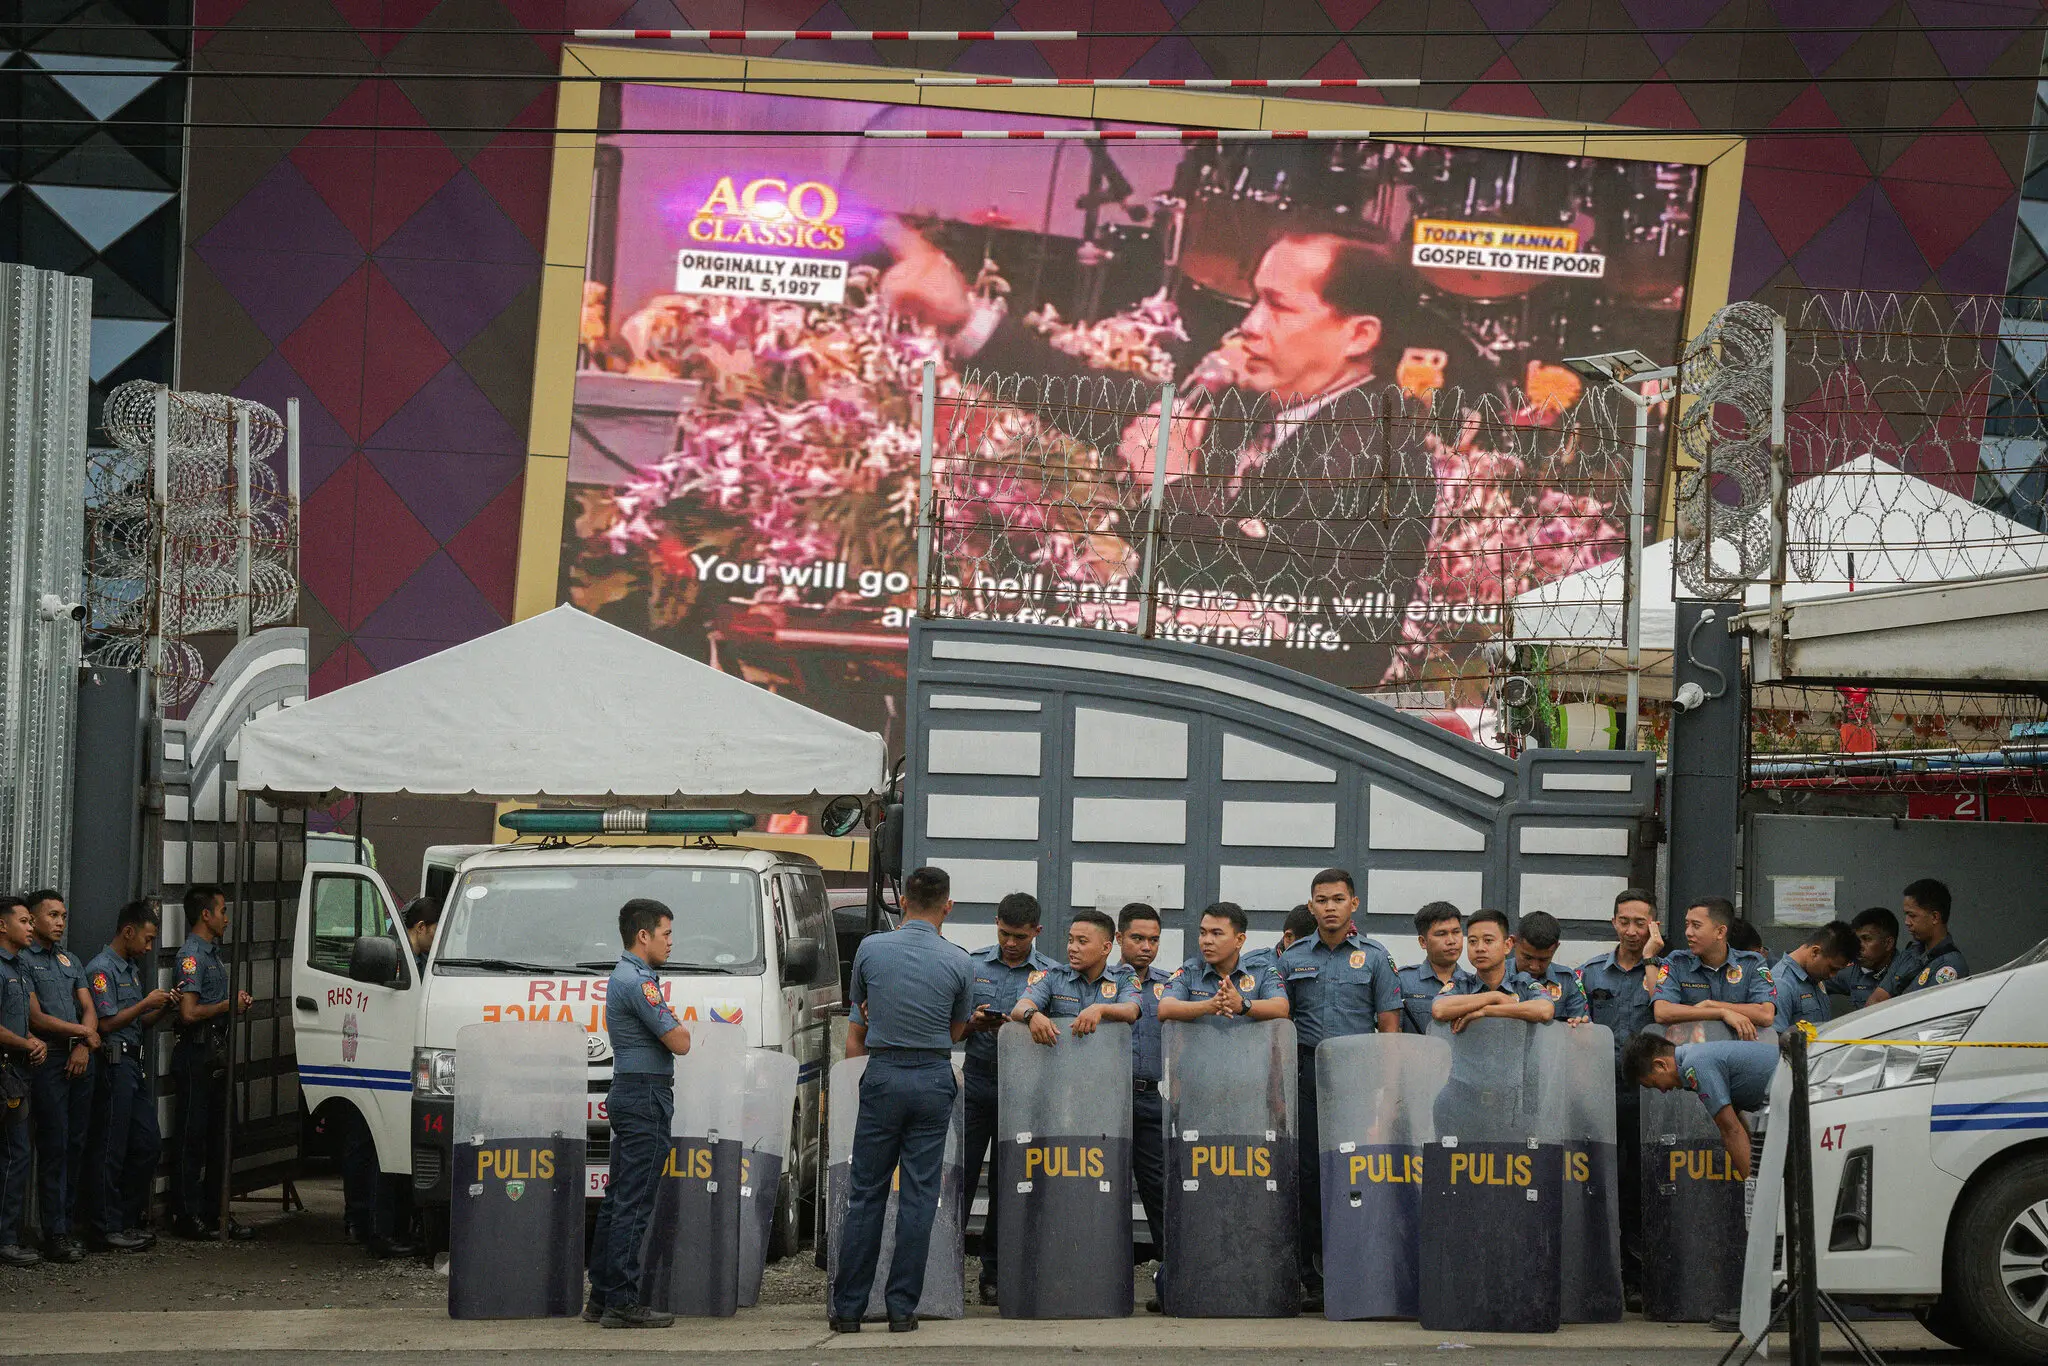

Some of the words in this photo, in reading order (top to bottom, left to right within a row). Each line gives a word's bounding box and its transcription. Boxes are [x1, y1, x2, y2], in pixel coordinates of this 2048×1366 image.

[688, 217, 845, 250] CLASSICS
[1424, 227, 1493, 245] TODAY'S
[682, 254, 786, 276] ORIGINALLY
[790, 262, 842, 280] AIRED
[1418, 247, 1487, 266] GOSPEL
[1491, 252, 1513, 269] TO
[1516, 254, 1548, 270] THE
[1552, 256, 1600, 273] POOR
[700, 274, 754, 292] APRIL
[760, 279, 821, 296] 5,1997
[691, 553, 766, 585] You
[778, 560, 846, 588] will
[859, 569, 909, 597] go
[930, 573, 961, 596] o
[974, 570, 1043, 599] hell
[1055, 577, 1129, 605] and
[1157, 580, 1239, 610] here
[1250, 592, 1321, 619] you
[1332, 591, 1396, 619] will
[1155, 619, 1273, 648] ternal
[1286, 620, 1351, 651] life.
[1954, 793, 1976, 815] 2
[327, 987, 353, 1008] RHS
[356, 991, 369, 1013] 11
[527, 980, 609, 1002] RHS
[423, 1113, 444, 1133] 14
[1820, 1124, 1847, 1151] 47
[477, 1148, 556, 1181] PULIS
[661, 1147, 713, 1179] LIS
[1025, 1146, 1105, 1179] PULIS
[1191, 1145, 1272, 1177] PULIS
[1450, 1152, 1532, 1187] PULIS
